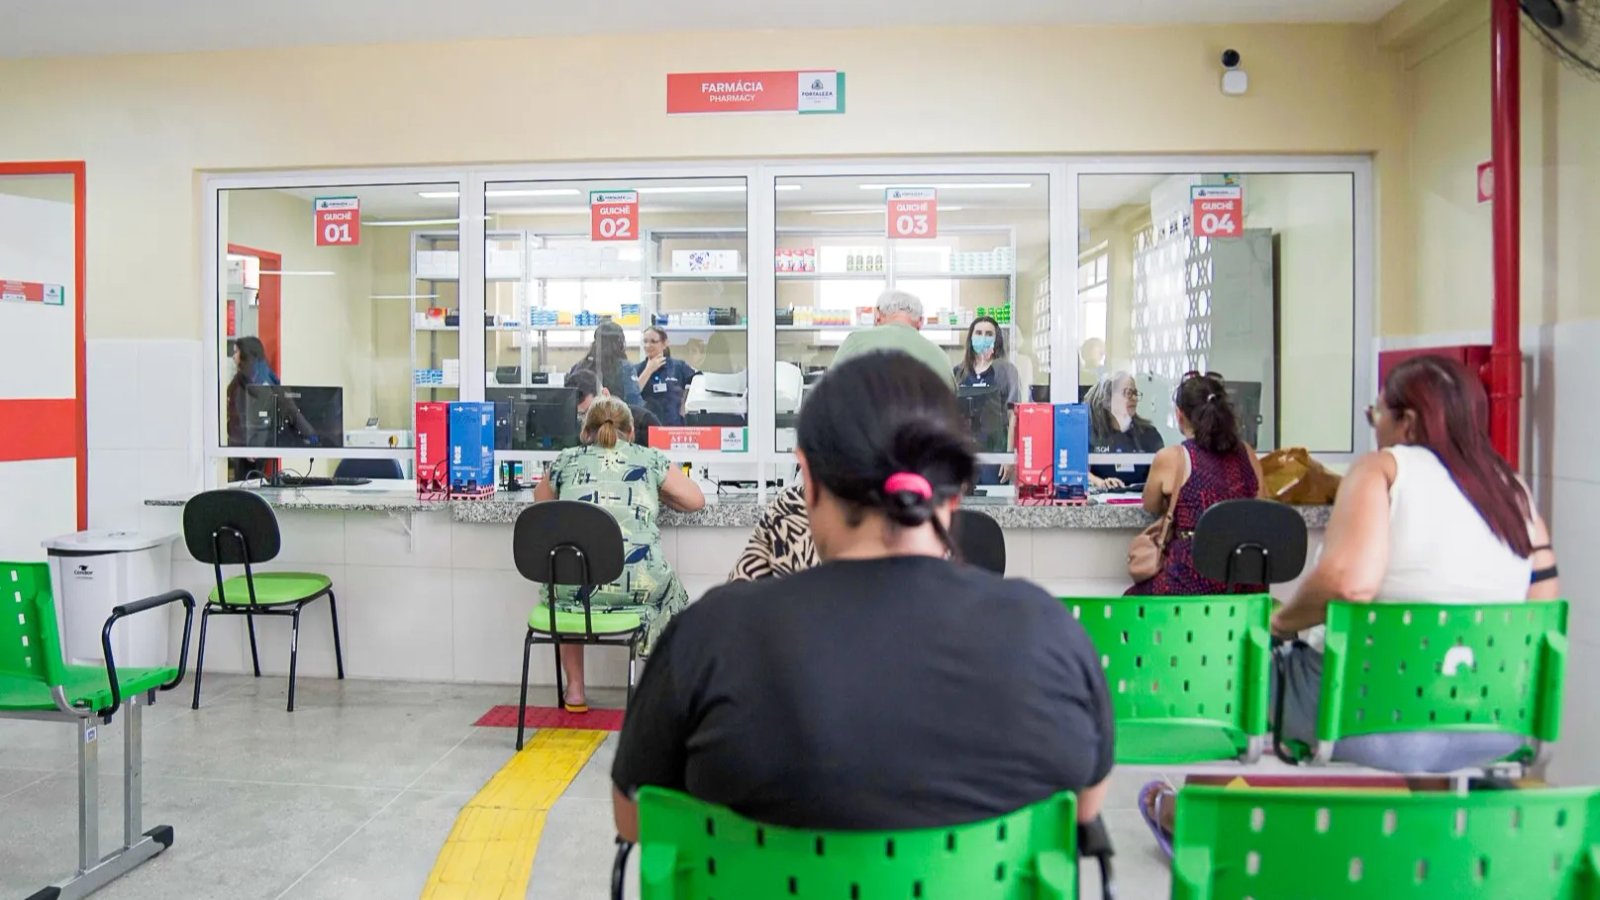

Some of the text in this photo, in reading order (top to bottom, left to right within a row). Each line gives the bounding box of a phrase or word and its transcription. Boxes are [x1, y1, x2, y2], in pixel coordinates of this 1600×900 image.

[701, 80, 763, 93] FARMÁCIA
[709, 94, 756, 103] PHARMACY
[600, 205, 630, 215] GUICHÊ
[896, 202, 928, 212] GUICHÊ
[1201, 200, 1234, 210] GUICHÊ
[324, 211, 352, 220] GUICHÊ
[600, 217, 631, 238] 02
[896, 214, 929, 235] 03
[1201, 213, 1235, 234] 04
[324, 223, 352, 243] 01
